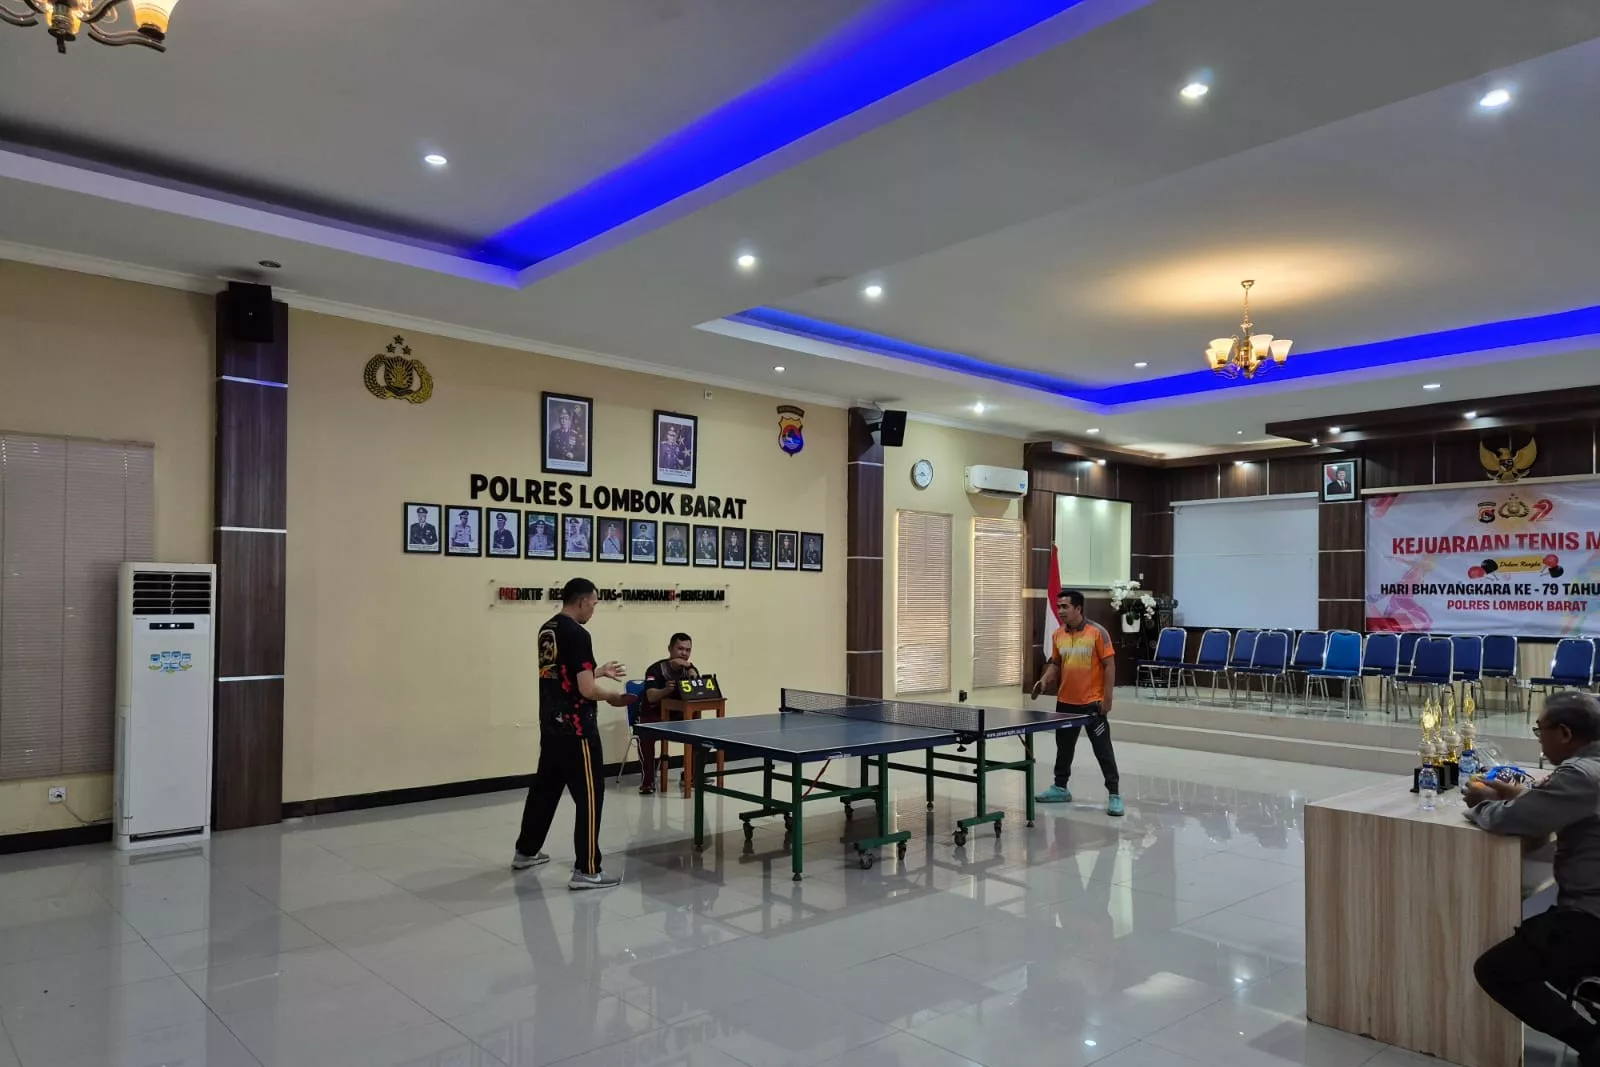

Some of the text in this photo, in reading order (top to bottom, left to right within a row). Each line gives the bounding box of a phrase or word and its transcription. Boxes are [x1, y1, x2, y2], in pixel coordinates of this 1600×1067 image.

[470, 474, 747, 520] POLRES LOMBOK BARAT
[1392, 534, 1510, 555] KEJUARAAN
[1515, 532, 1579, 551] TENIS
[1380, 584, 1409, 595] HARI
[1411, 584, 1511, 595] BHAYANGKARA
[1514, 584, 1531, 595] KE
[1542, 583, 1558, 595] 79
[1447, 600, 1587, 611] POLRES LOMBOK BARAT
[681, 680, 692, 692] 5
[705, 679, 715, 690] 4
